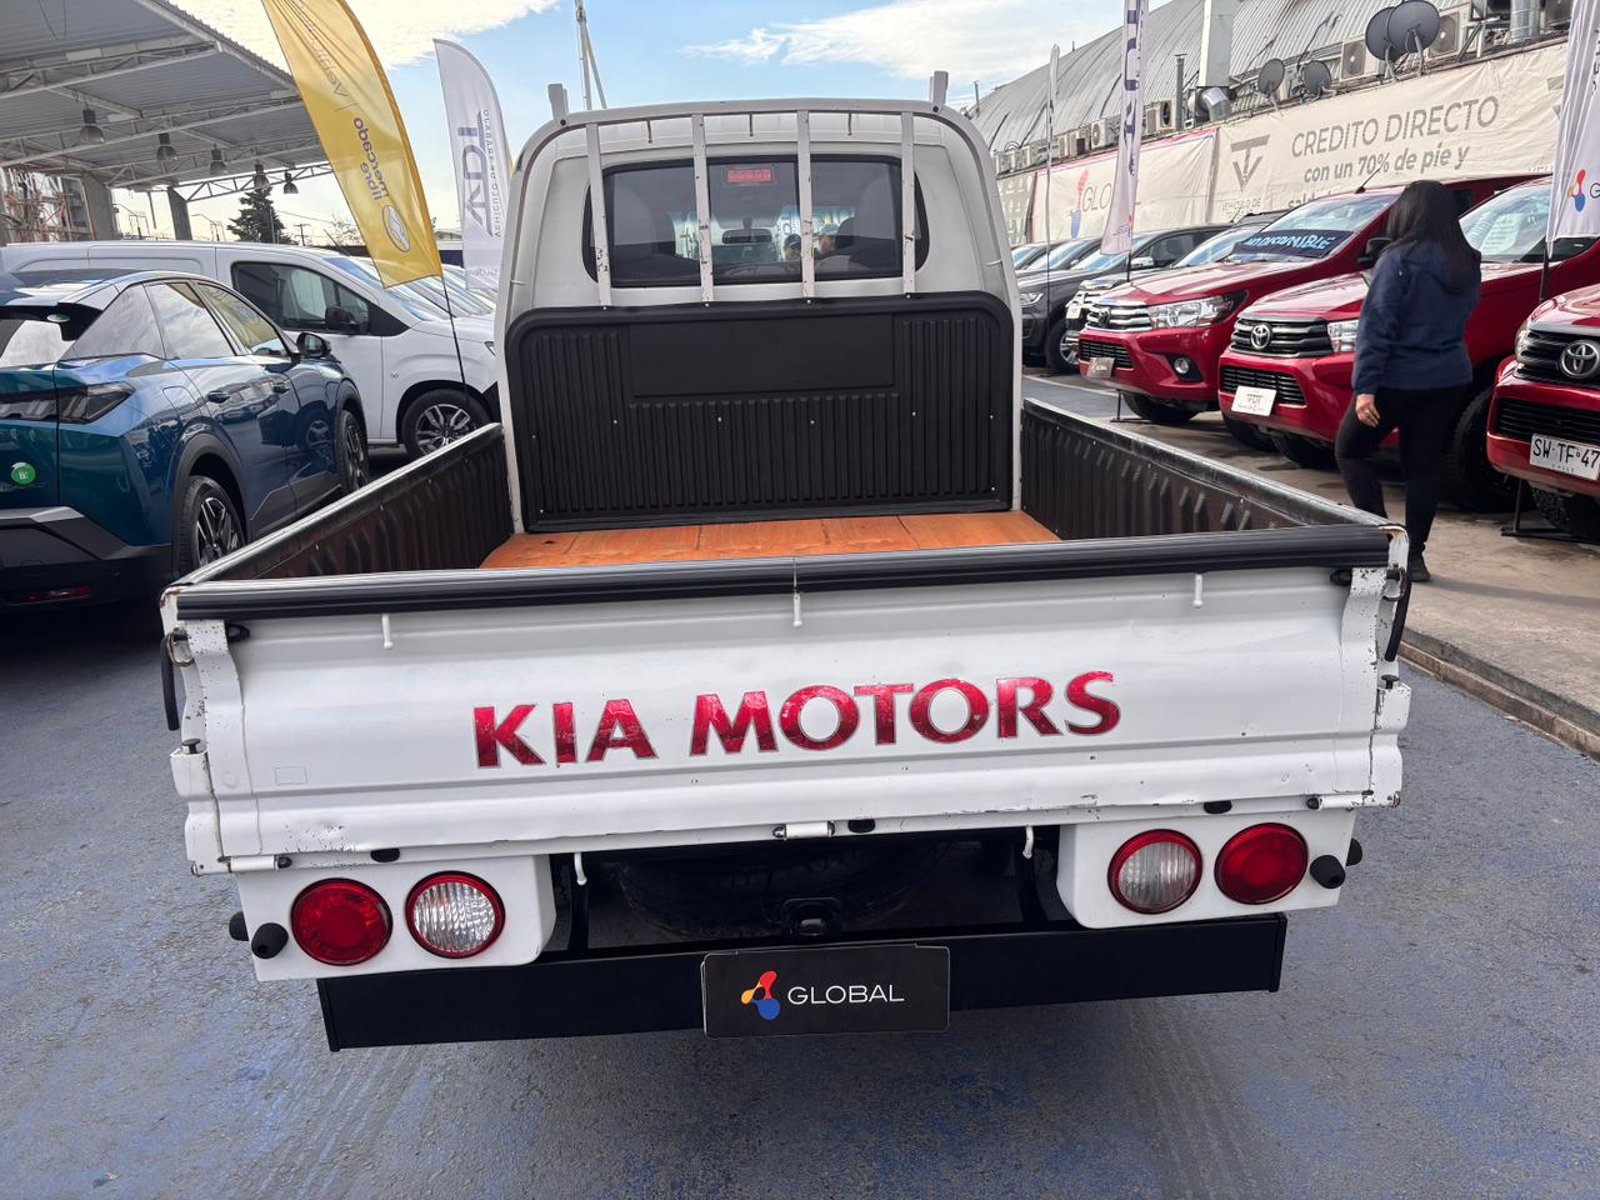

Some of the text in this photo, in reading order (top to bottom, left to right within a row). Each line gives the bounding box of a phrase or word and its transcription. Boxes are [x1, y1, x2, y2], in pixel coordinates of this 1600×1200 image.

[1292, 96, 1499, 157] CREDITO DIRECTO
[1304, 165, 1330, 183] con
[1334, 162, 1353, 179] un
[1358, 152, 1390, 175] 70%
[1394, 148, 1417, 171] de
[1454, 146, 1470, 170] y
[473, 671, 1121, 769] KIA MOTORS
[787, 984, 905, 1005] GLOBAL
